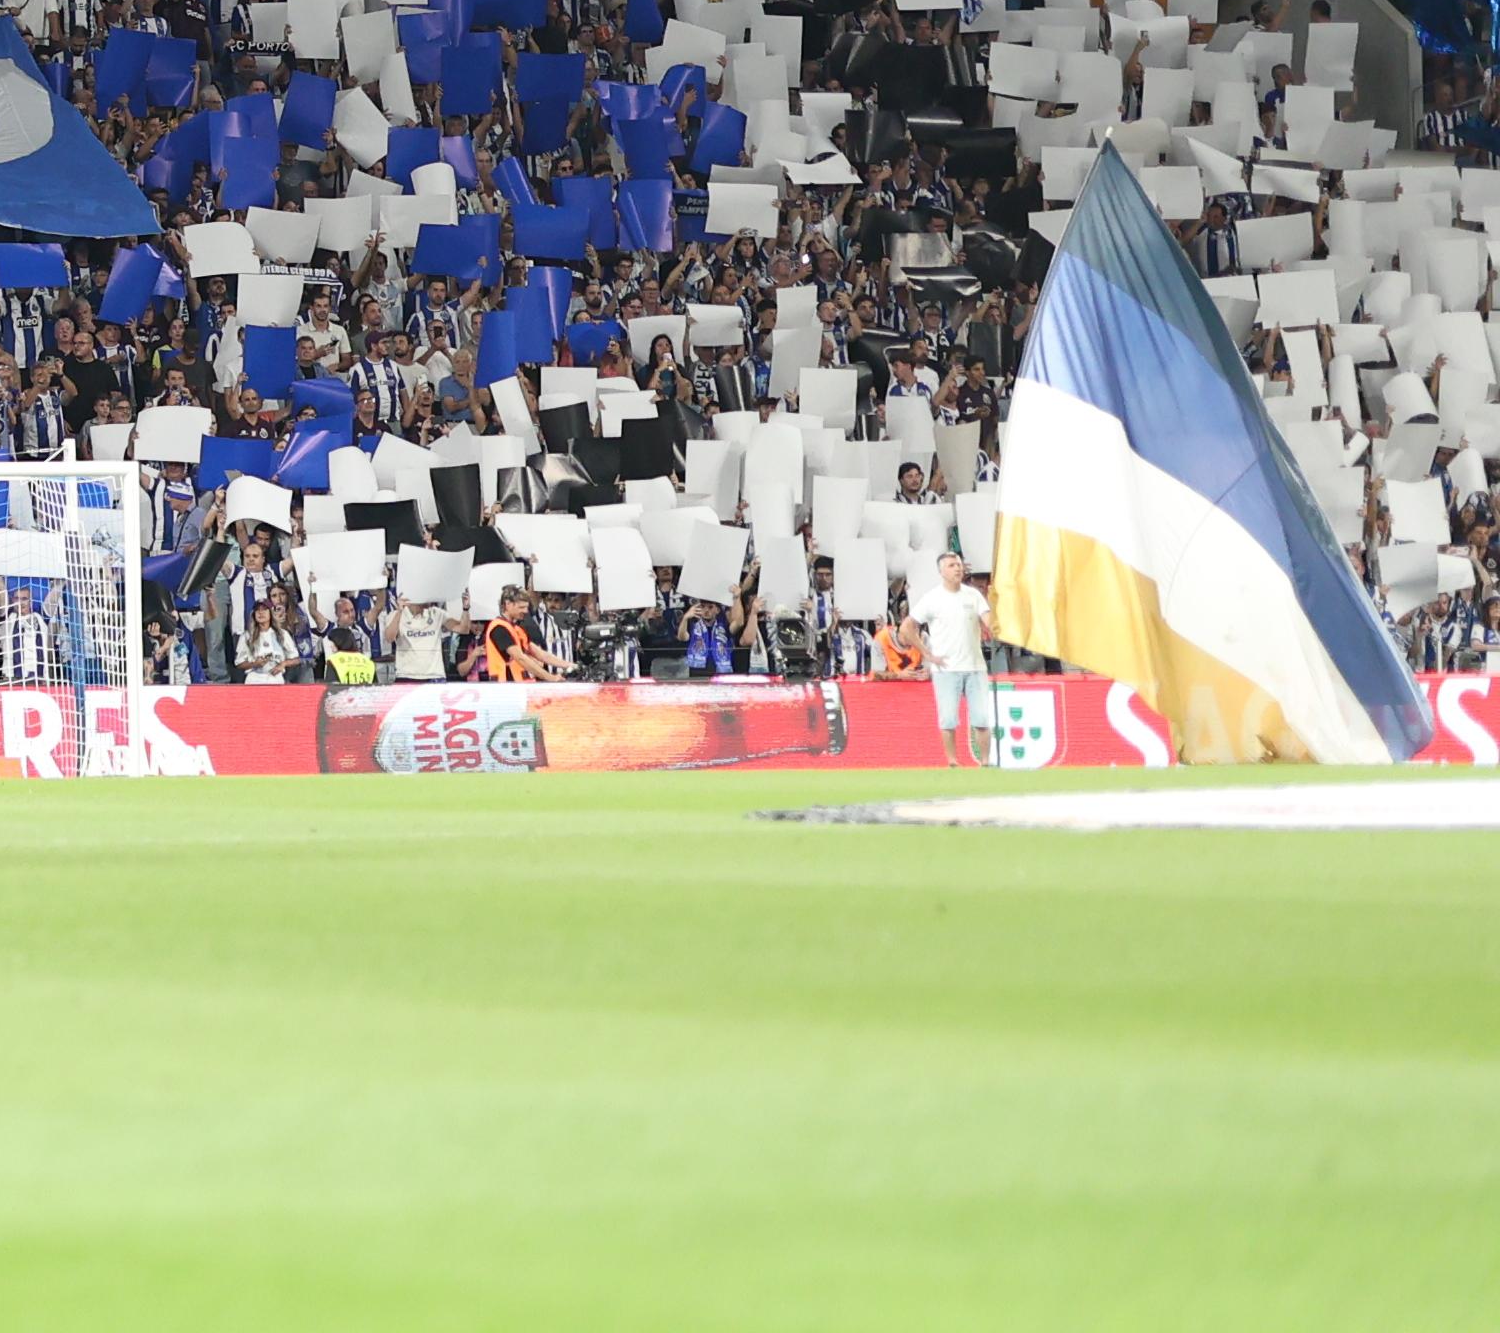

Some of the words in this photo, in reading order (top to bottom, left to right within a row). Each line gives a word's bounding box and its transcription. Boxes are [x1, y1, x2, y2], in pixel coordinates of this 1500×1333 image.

[247, 40, 290, 53] PORTO
[17, 316, 38, 327] meo
[439, 688, 484, 773] SAGR
